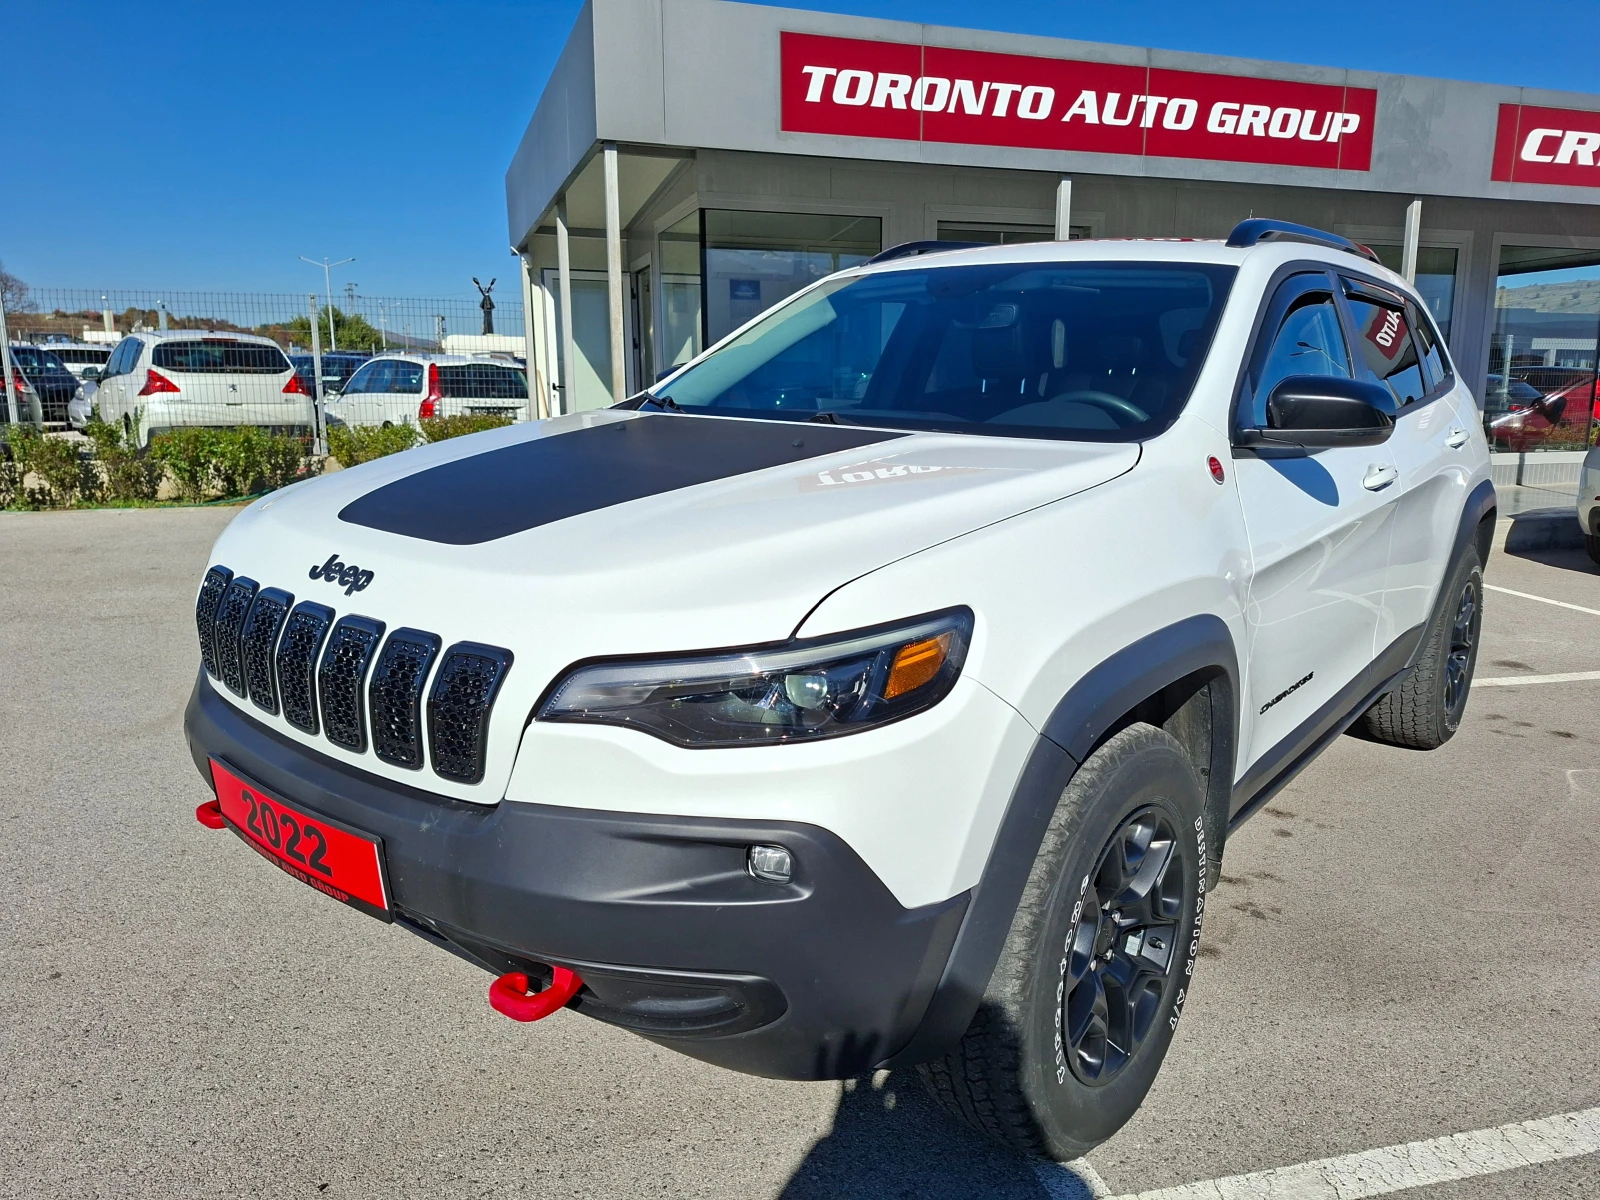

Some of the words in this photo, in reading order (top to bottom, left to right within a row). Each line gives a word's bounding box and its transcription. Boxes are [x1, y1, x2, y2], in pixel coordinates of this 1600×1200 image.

[801, 65, 1055, 120] TORONTO
[1060, 90, 1198, 131] AUTO
[1207, 101, 1360, 143] GROUP
[1520, 128, 1600, 167] CR
[309, 554, 374, 597] Jeep
[241, 789, 333, 878] 2022
[281, 861, 307, 884] AUTO
[310, 877, 349, 903] GROUP
[1185, 816, 1207, 976] DESTINATION
